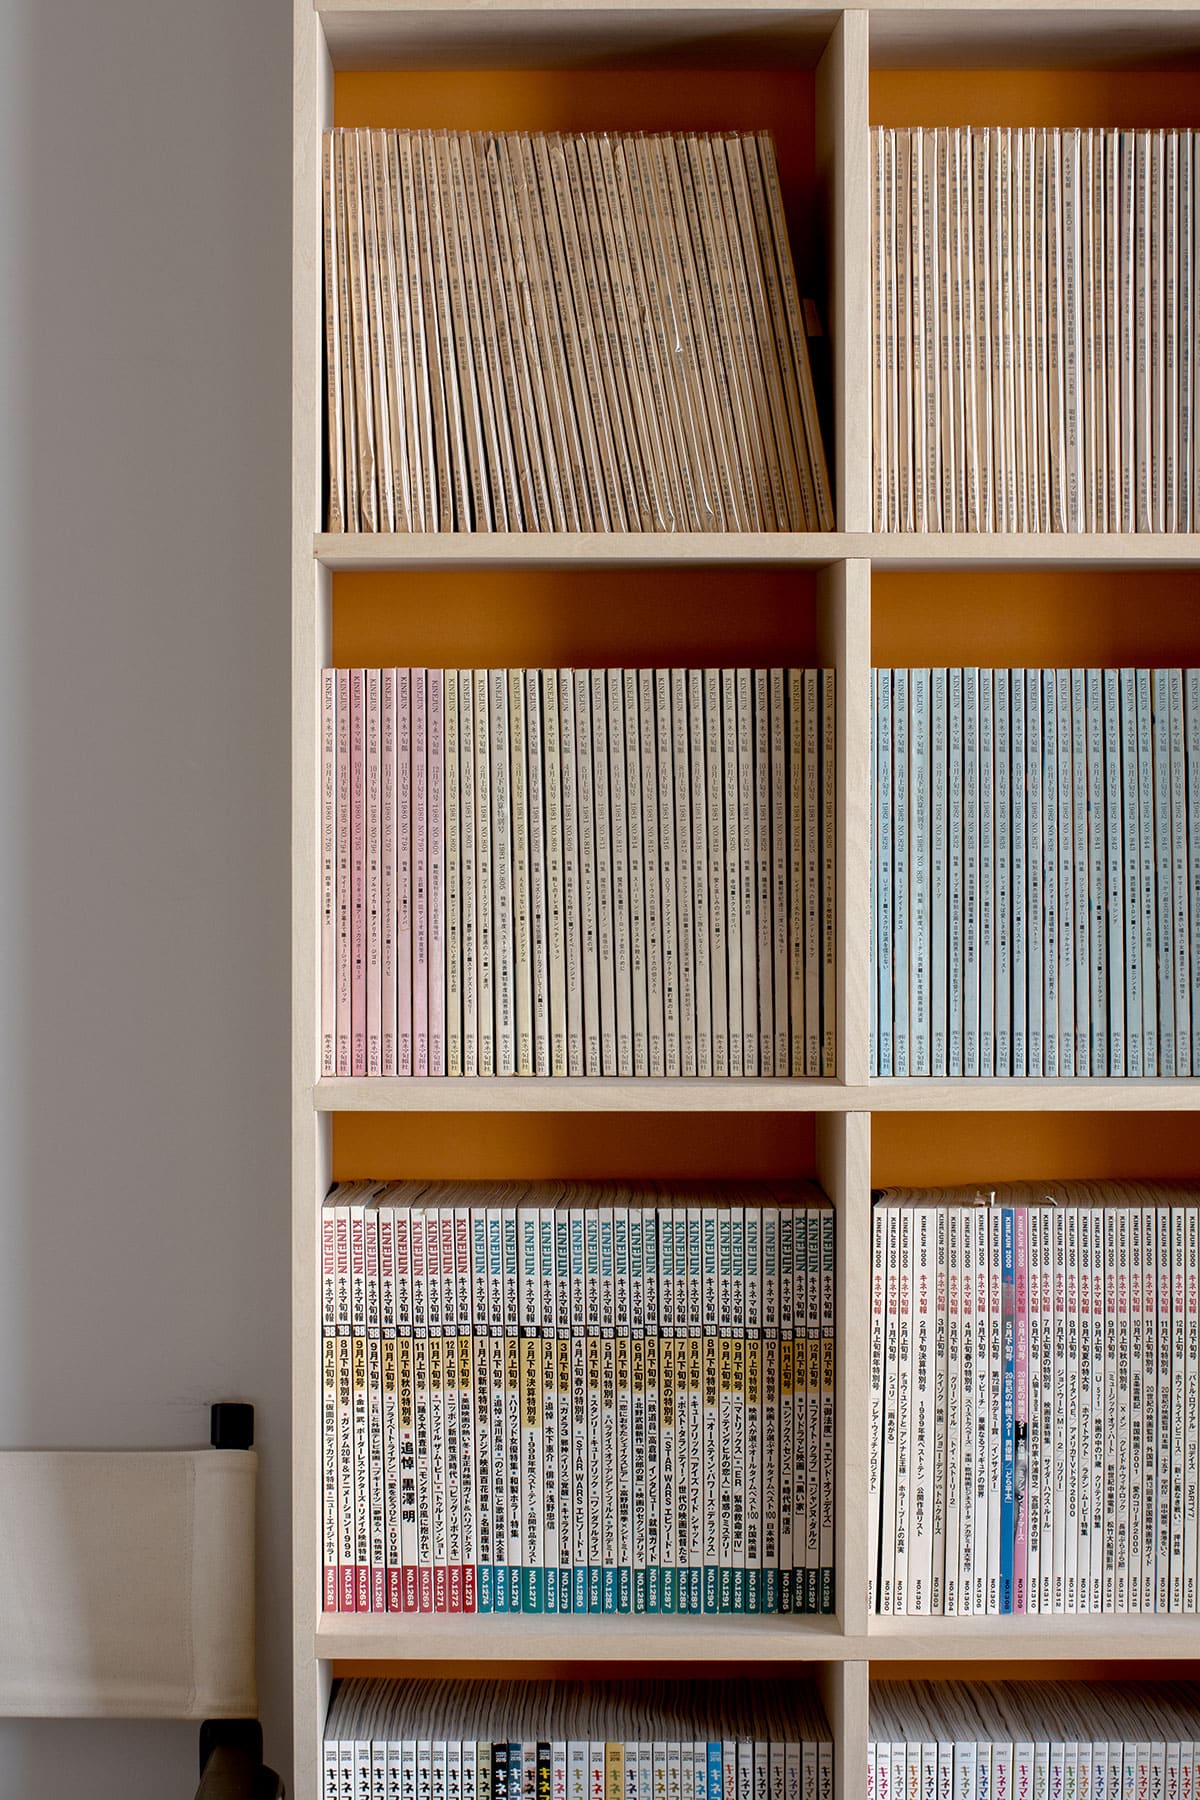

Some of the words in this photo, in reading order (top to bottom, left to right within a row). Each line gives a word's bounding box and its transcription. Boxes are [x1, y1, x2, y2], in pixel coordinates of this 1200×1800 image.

[337, 1219, 348, 1274] KINEJUN
[382, 1222, 392, 1276] KINEJUN
[398, 1220, 407, 1274] KINEJUN
[428, 1221, 438, 1274] KINEJUN
[505, 1220, 516, 1275] KINEJUN
[524, 1221, 535, 1275] KINEJUN
[572, 1220, 582, 1274] KINEJUN
[588, 1219, 597, 1273] KINEJUN
[662, 1221, 672, 1276] KINEJUN
[690, 1221, 700, 1275] KINEJUN
[720, 1221, 730, 1275] KINEJUN
[748, 1221, 757, 1276] KINEJUN
[809, 1218, 818, 1273] KINEJUN
[823, 1217, 833, 1271] KINEJUN
[338, 1277, 348, 1322] キネマ旬報
[383, 1280, 393, 1322] キネマ旬報
[399, 1278, 409, 1321] キネマ旬報
[430, 1278, 439, 1321] キネマ旬報
[507, 1278, 516, 1321] キネマ旬報
[526, 1278, 535, 1321] キネマ旬報
[574, 1278, 583, 1321] キネマ旬報
[589, 1277, 598, 1321] キネマ旬報
[664, 1279, 673, 1323] キネマ旬報
[690, 1278, 699, 1323] キネマ旬報
[721, 1279, 730, 1323] キネマ旬報
[748, 1281, 757, 1323] キネマ旬報
[809, 1277, 818, 1321] キネマ旬報
[823, 1276, 833, 1320] キネマ旬報
[874, 1275, 882, 1315] キネマ旬報
[919, 1275, 928, 1314] キネマ旬報
[937, 1272, 946, 1312] キネマ旬報
[977, 1273, 985, 1313] キネマ旬報
[1056, 1272, 1064, 1313] キネマ旬報
[1068, 1274, 1076, 1314] キネマ旬報
[1118, 1274, 1126, 1314] キネマ旬報
[1189, 1274, 1197, 1314] キネマ旬報
[872, 1321, 881, 1391] 1月上旬新年特別号
[919, 1321, 927, 1392] 2月下旬決算特別号
[1057, 1320, 1065, 1360] 7月下旬号
[1119, 1321, 1127, 1391] 10月上旬秋の特別号
[1189, 1321, 1197, 1360] 12月下旬号
[340, 1340, 349, 1406] 8月下旬特別号
[384, 1342, 395, 1391] 10月上旬号
[400, 1340, 411, 1426] 10月下旬秋の特別号
[431, 1341, 440, 1389] 11月下旬号
[508, 1341, 518, 1389] 2月上旬号
[527, 1341, 537, 1426] 2月下旬決算特別号
[575, 1341, 584, 1424] 4月上旬春の特別号
[589, 1341, 598, 1390] 4月下旬号
[664, 1342, 673, 1425] 7月上旬夏の特別号
[691, 1342, 699, 1390] 8月上旬号
[722, 1343, 730, 1391] 9月上旬号
[748, 1343, 759, 1403] 10月上旬特別号
[810, 1345, 819, 1391] 12月上旬号
[824, 1343, 833, 1385] 12月下旬号
[401, 1441, 414, 1470] 追悼
[402, 1479, 415, 1506] 黒澤
[403, 1510, 415, 1523] 明
[821, 1766, 830, 1800] キネマ
[909, 1765, 918, 1800] キネマ
[979, 1765, 988, 1800] キネマ
